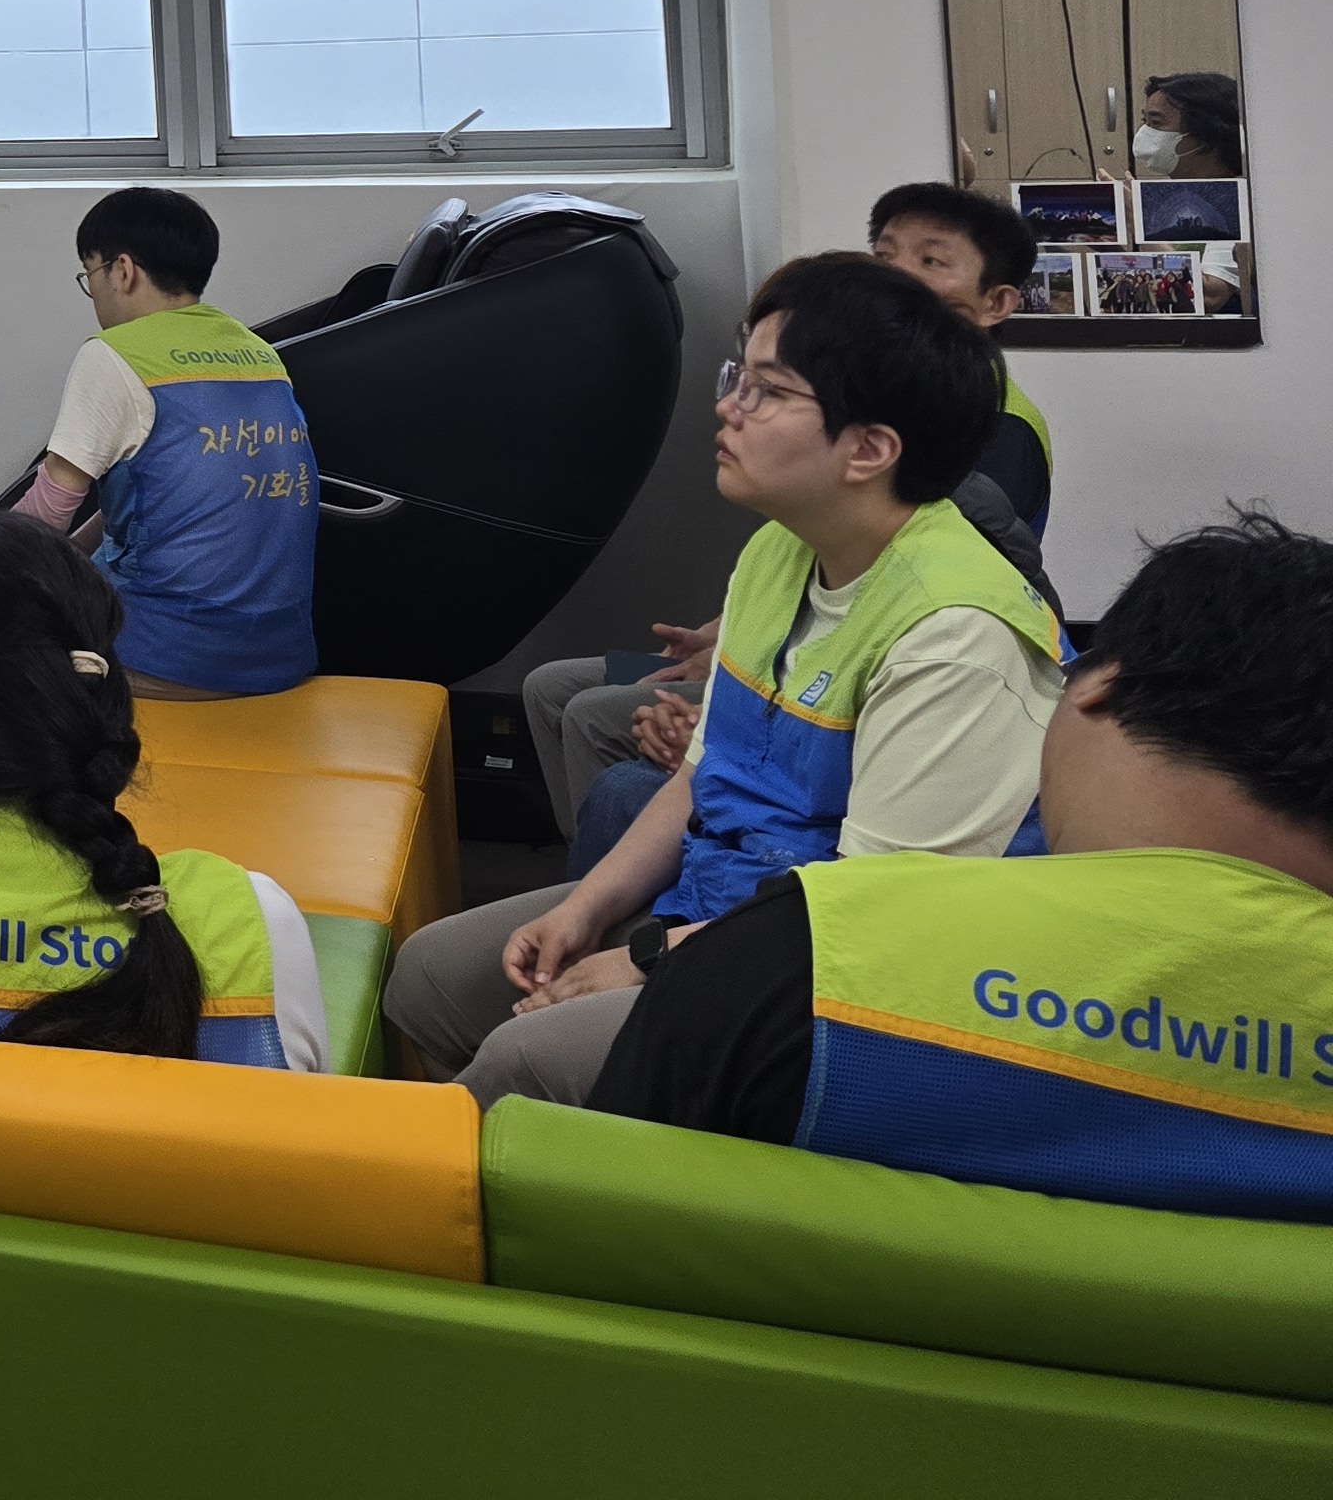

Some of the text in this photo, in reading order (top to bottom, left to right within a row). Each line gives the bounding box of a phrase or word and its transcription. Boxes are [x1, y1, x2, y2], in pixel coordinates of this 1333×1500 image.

[241, 462, 311, 507] 기회를
[39, 924, 130, 970] Sto
[972, 968, 1293, 1080] Goodwill
